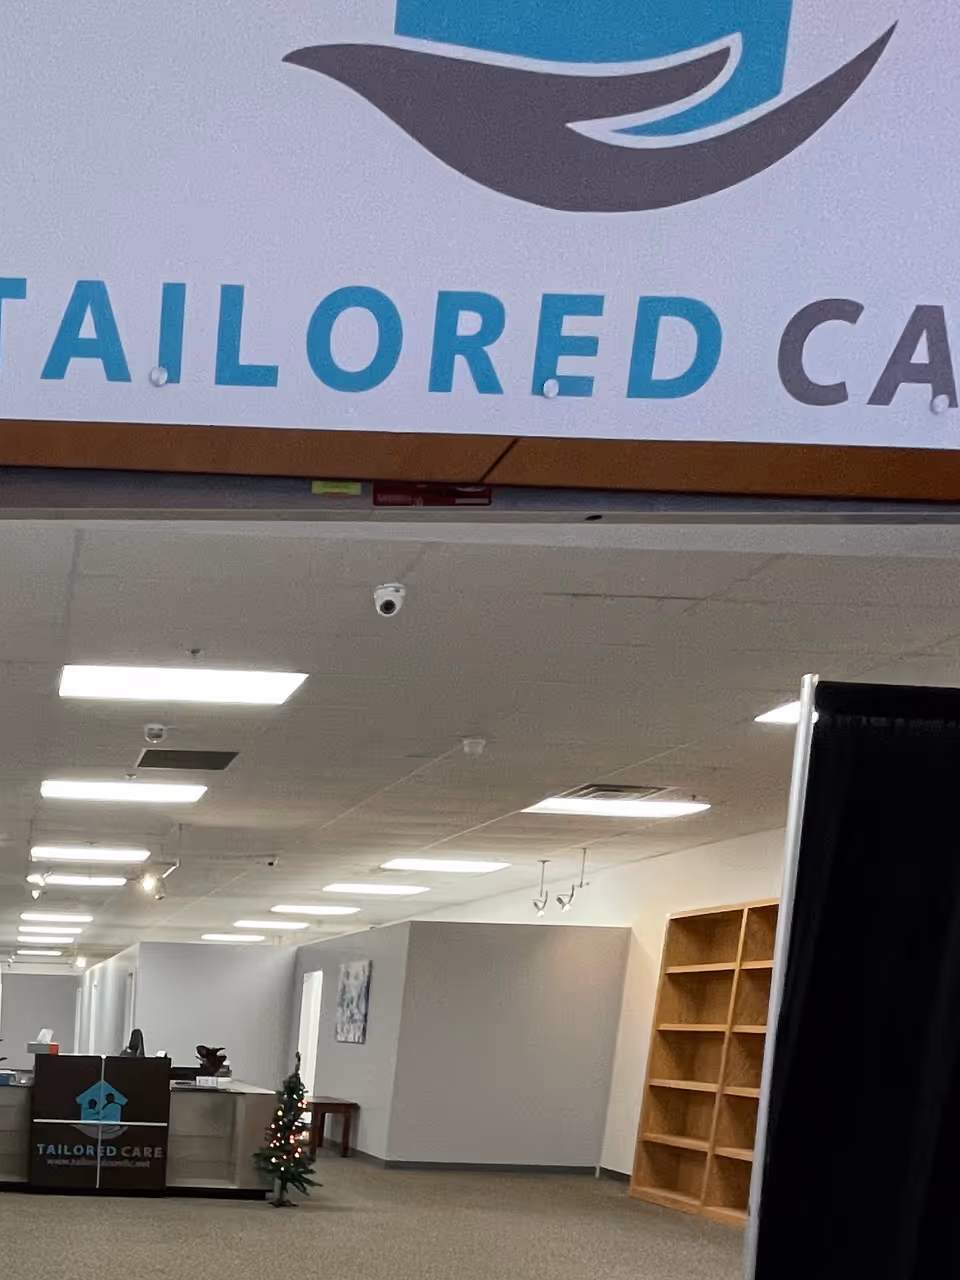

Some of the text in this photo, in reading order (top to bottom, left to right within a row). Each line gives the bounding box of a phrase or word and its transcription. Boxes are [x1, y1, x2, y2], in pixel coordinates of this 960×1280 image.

[777, 298, 959, 412] CA
[36, 1143, 163, 1159] TAILORED CARE
